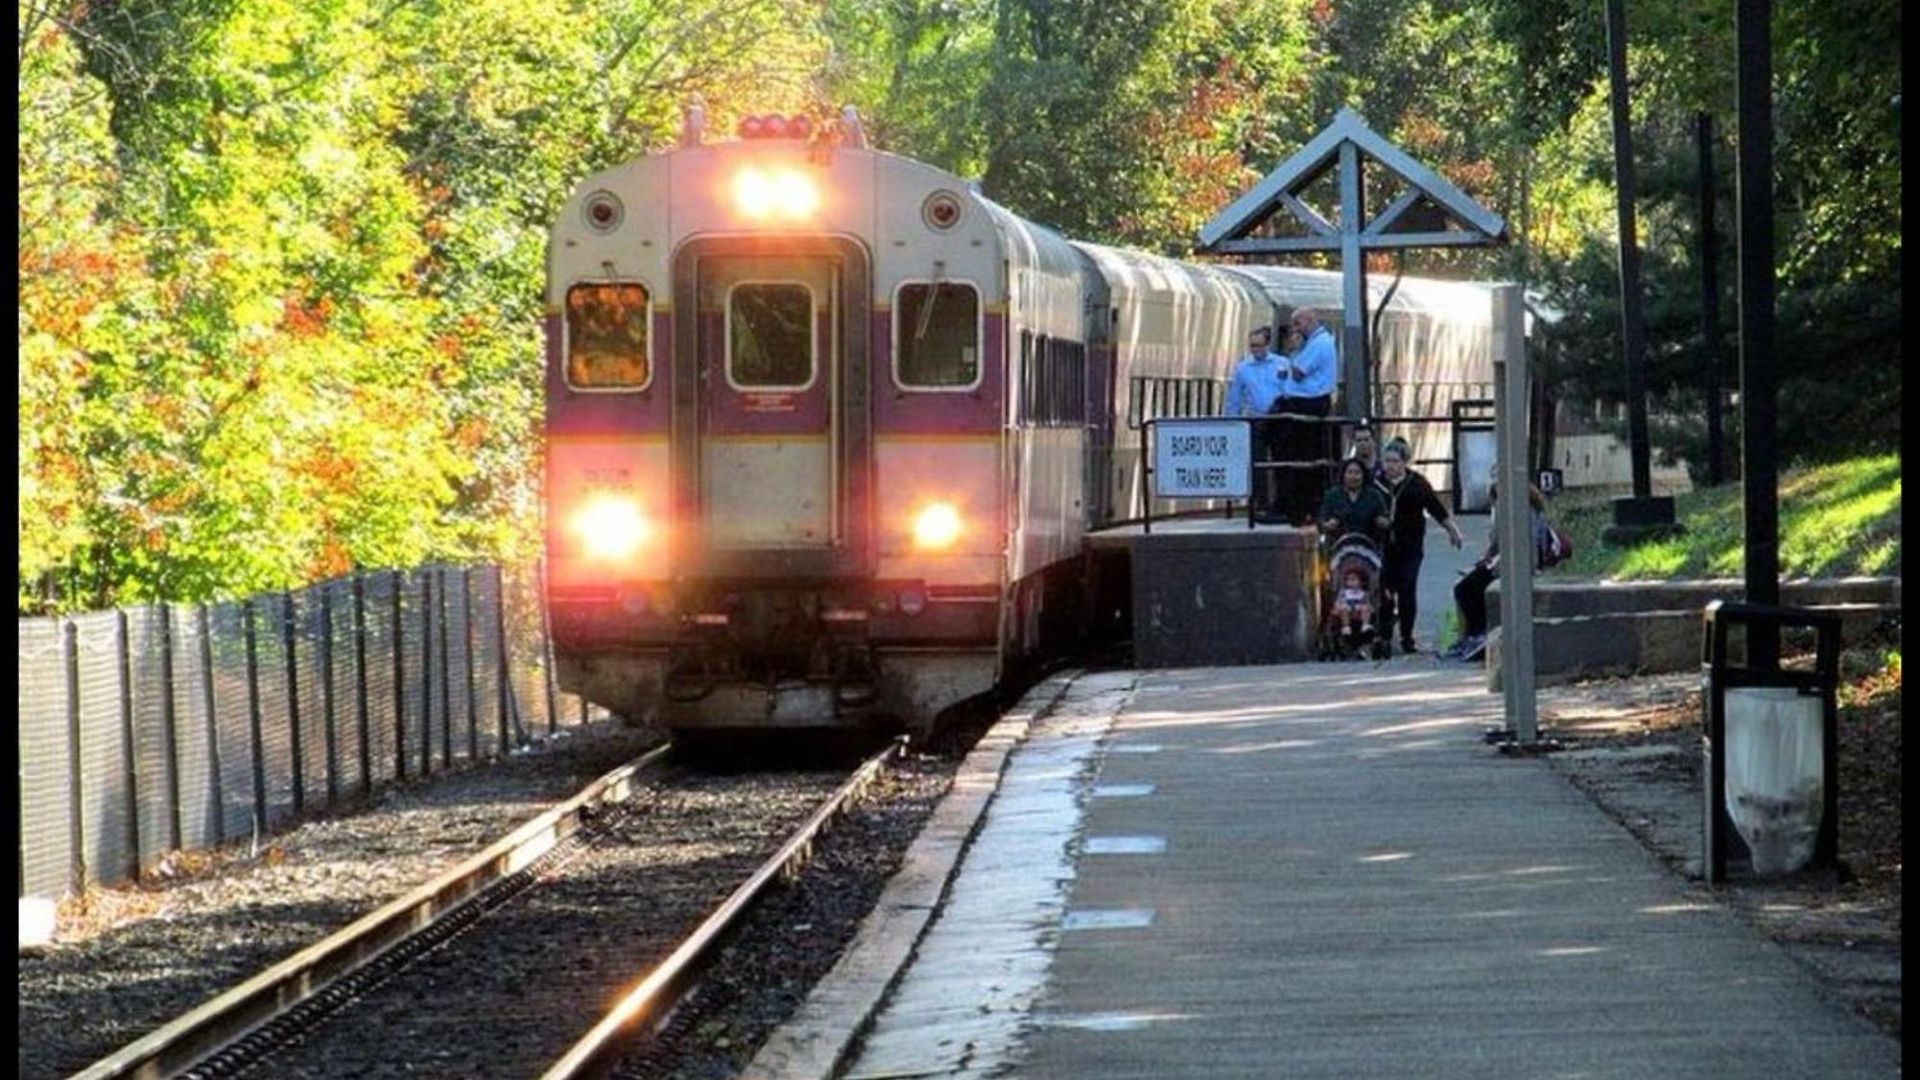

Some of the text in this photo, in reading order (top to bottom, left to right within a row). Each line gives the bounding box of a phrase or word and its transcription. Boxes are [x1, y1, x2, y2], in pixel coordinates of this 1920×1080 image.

[1171, 435, 1229, 456] BOARD YOUR
[1176, 468, 1226, 488] TRAIN HERE
